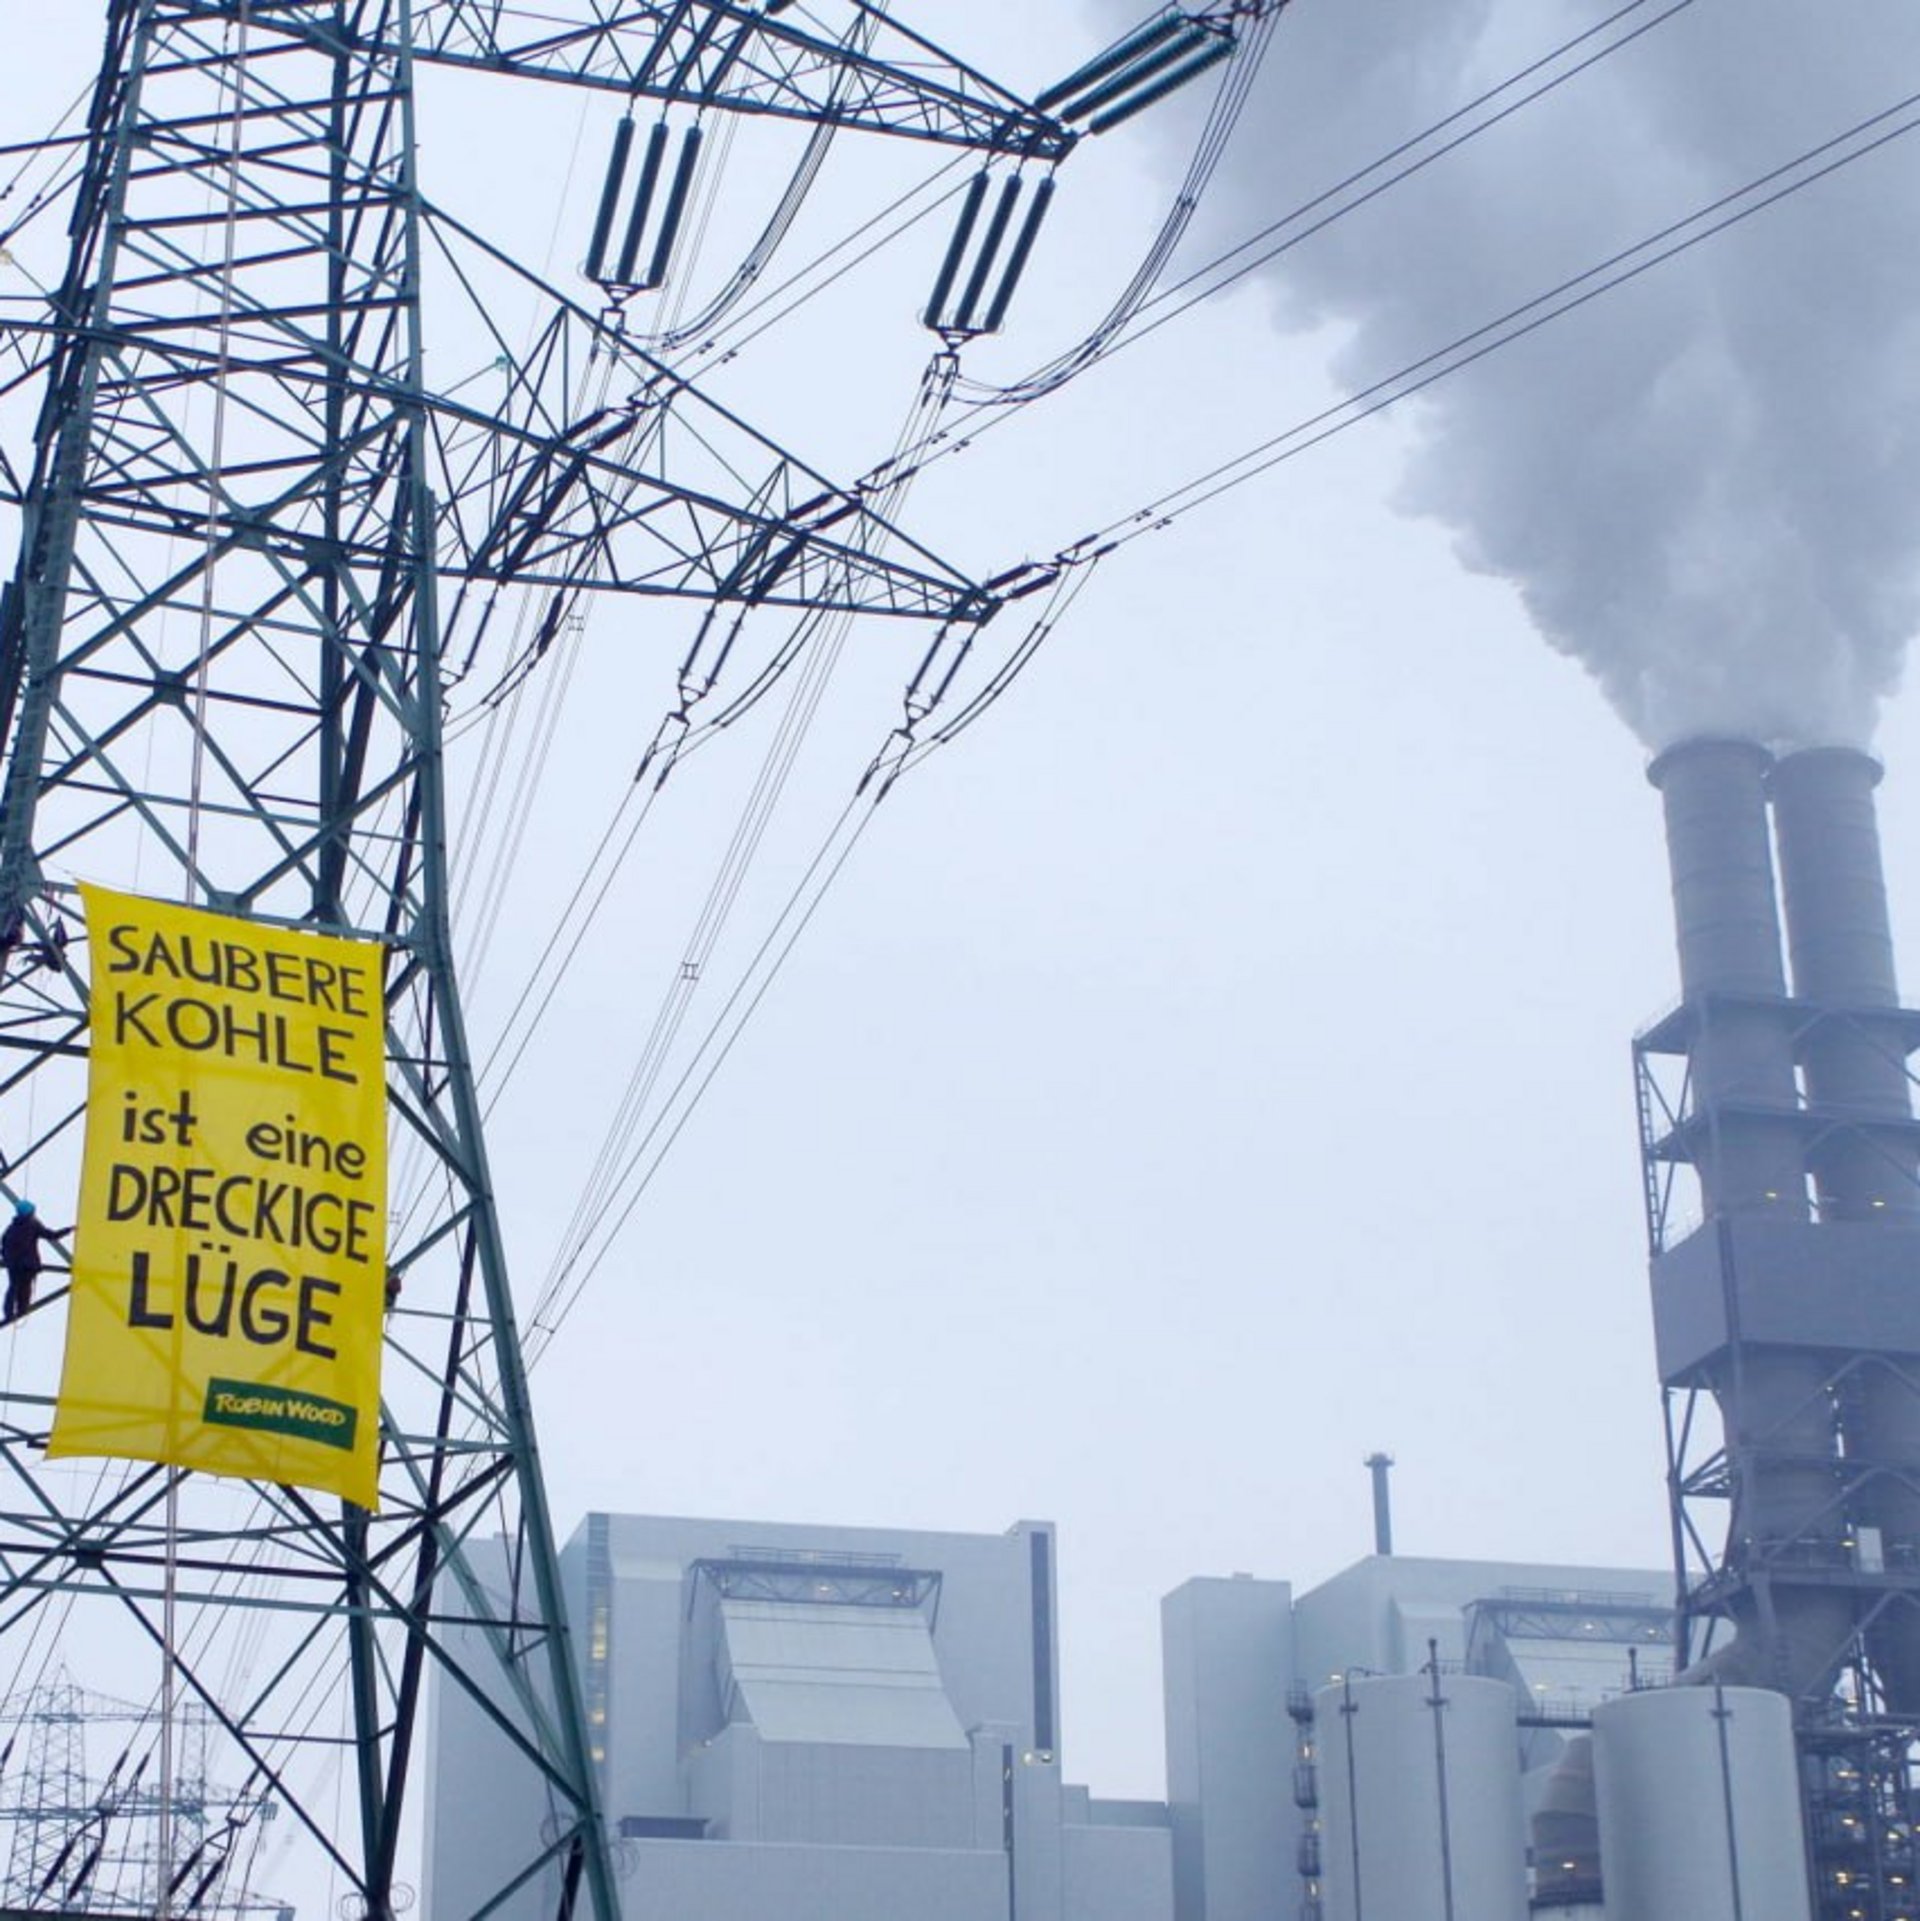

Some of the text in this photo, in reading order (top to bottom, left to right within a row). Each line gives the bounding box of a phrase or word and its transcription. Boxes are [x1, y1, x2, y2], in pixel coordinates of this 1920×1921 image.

[109, 925, 369, 1018] SAUBERE
[115, 991, 358, 1084] KOHLE
[123, 1090, 366, 1179] ist eine
[107, 1163, 375, 1264] DRECKIGE
[128, 1242, 341, 1360] LÜGE
